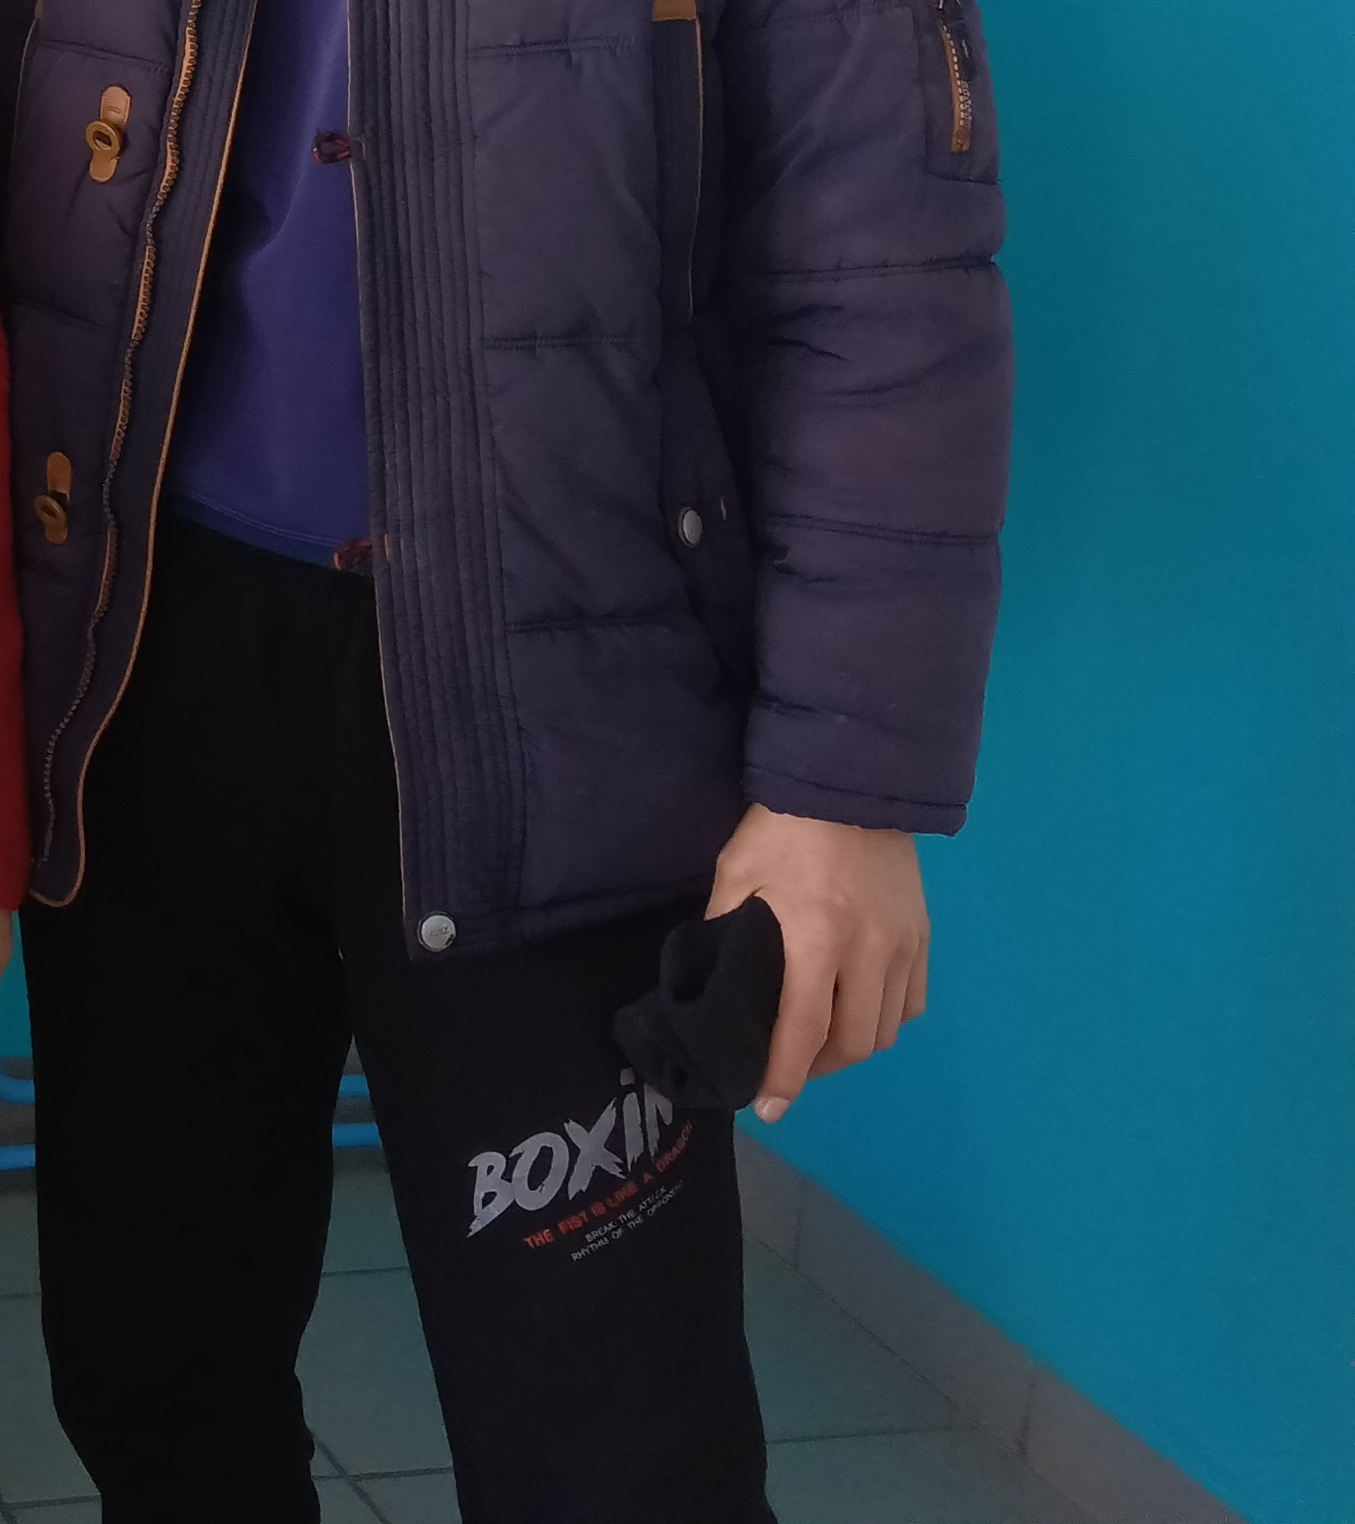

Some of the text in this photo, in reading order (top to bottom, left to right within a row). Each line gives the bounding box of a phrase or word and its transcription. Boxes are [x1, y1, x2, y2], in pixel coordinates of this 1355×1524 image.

[523, 1228, 554, 1249] THE
[558, 1211, 589, 1234] FIST
[607, 1181, 638, 1207] LIKE
